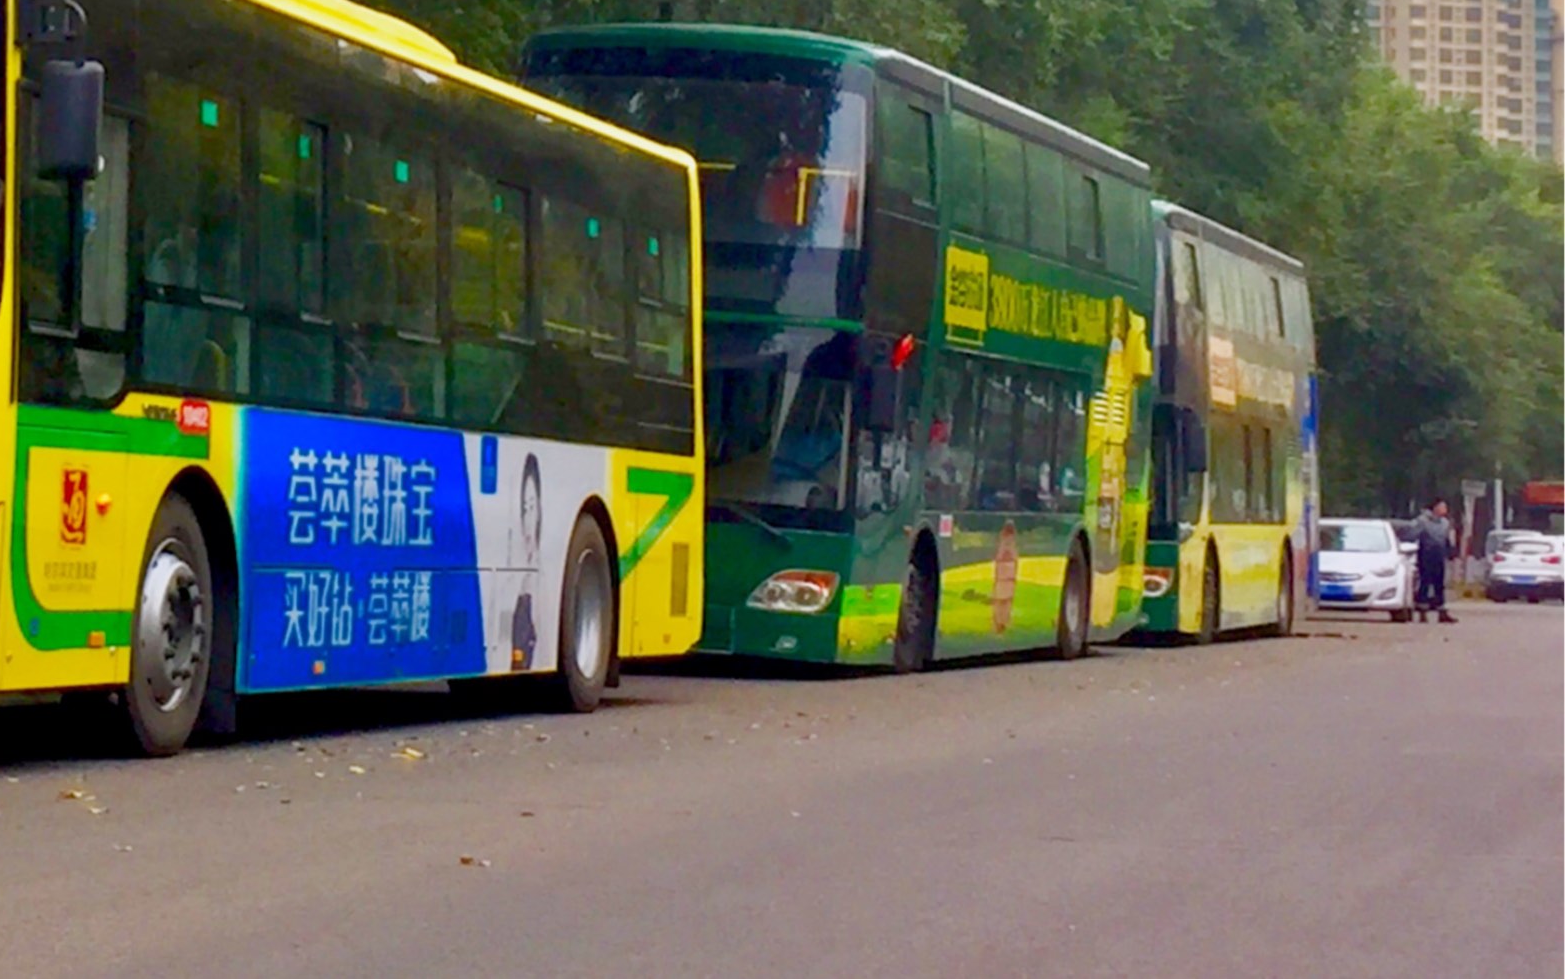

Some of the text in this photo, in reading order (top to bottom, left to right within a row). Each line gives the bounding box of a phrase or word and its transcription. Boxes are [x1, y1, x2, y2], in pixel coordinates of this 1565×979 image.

[289, 447, 435, 545] 荟萃楼珠宝
